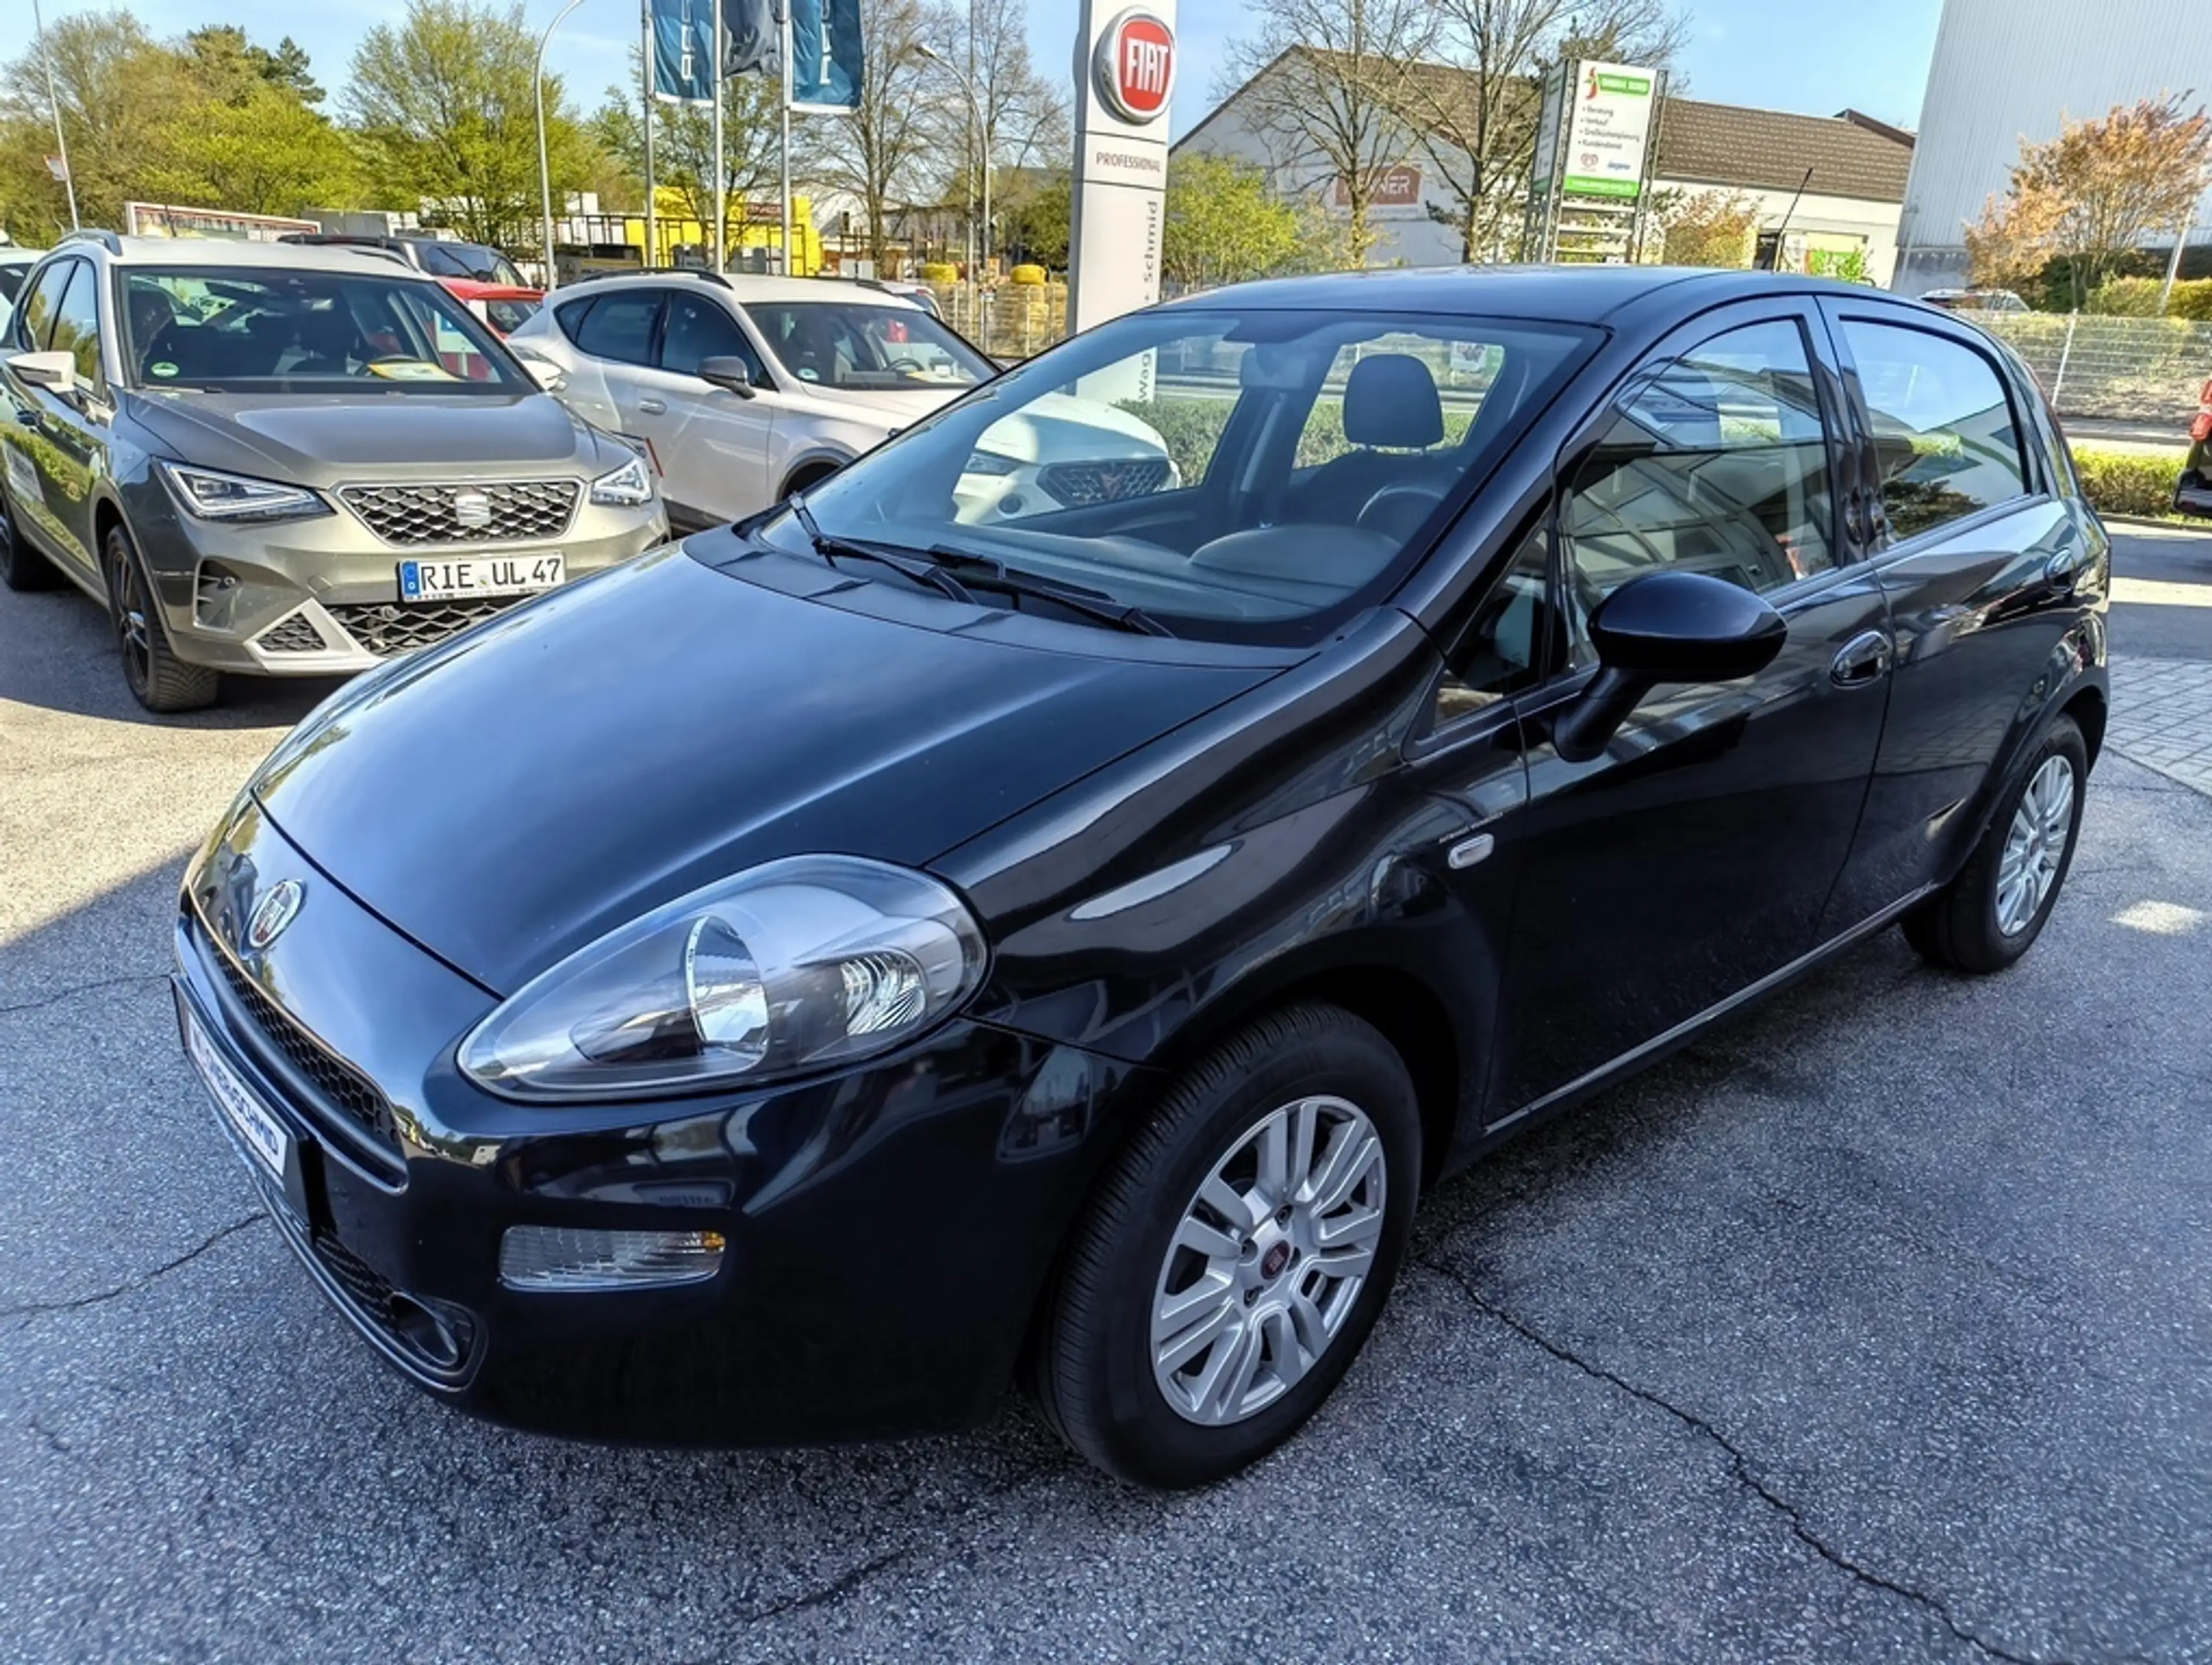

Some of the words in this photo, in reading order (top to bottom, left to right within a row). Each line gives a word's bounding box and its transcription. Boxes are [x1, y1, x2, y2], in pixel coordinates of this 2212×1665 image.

[1126, 36, 1169, 95] FIAT
[1096, 151, 1161, 173] PROFESSIONAL
[1144, 201, 1158, 283] Schmid
[421, 564, 474, 591] RIE
[491, 561, 526, 586] UL
[532, 558, 561, 583] 47
